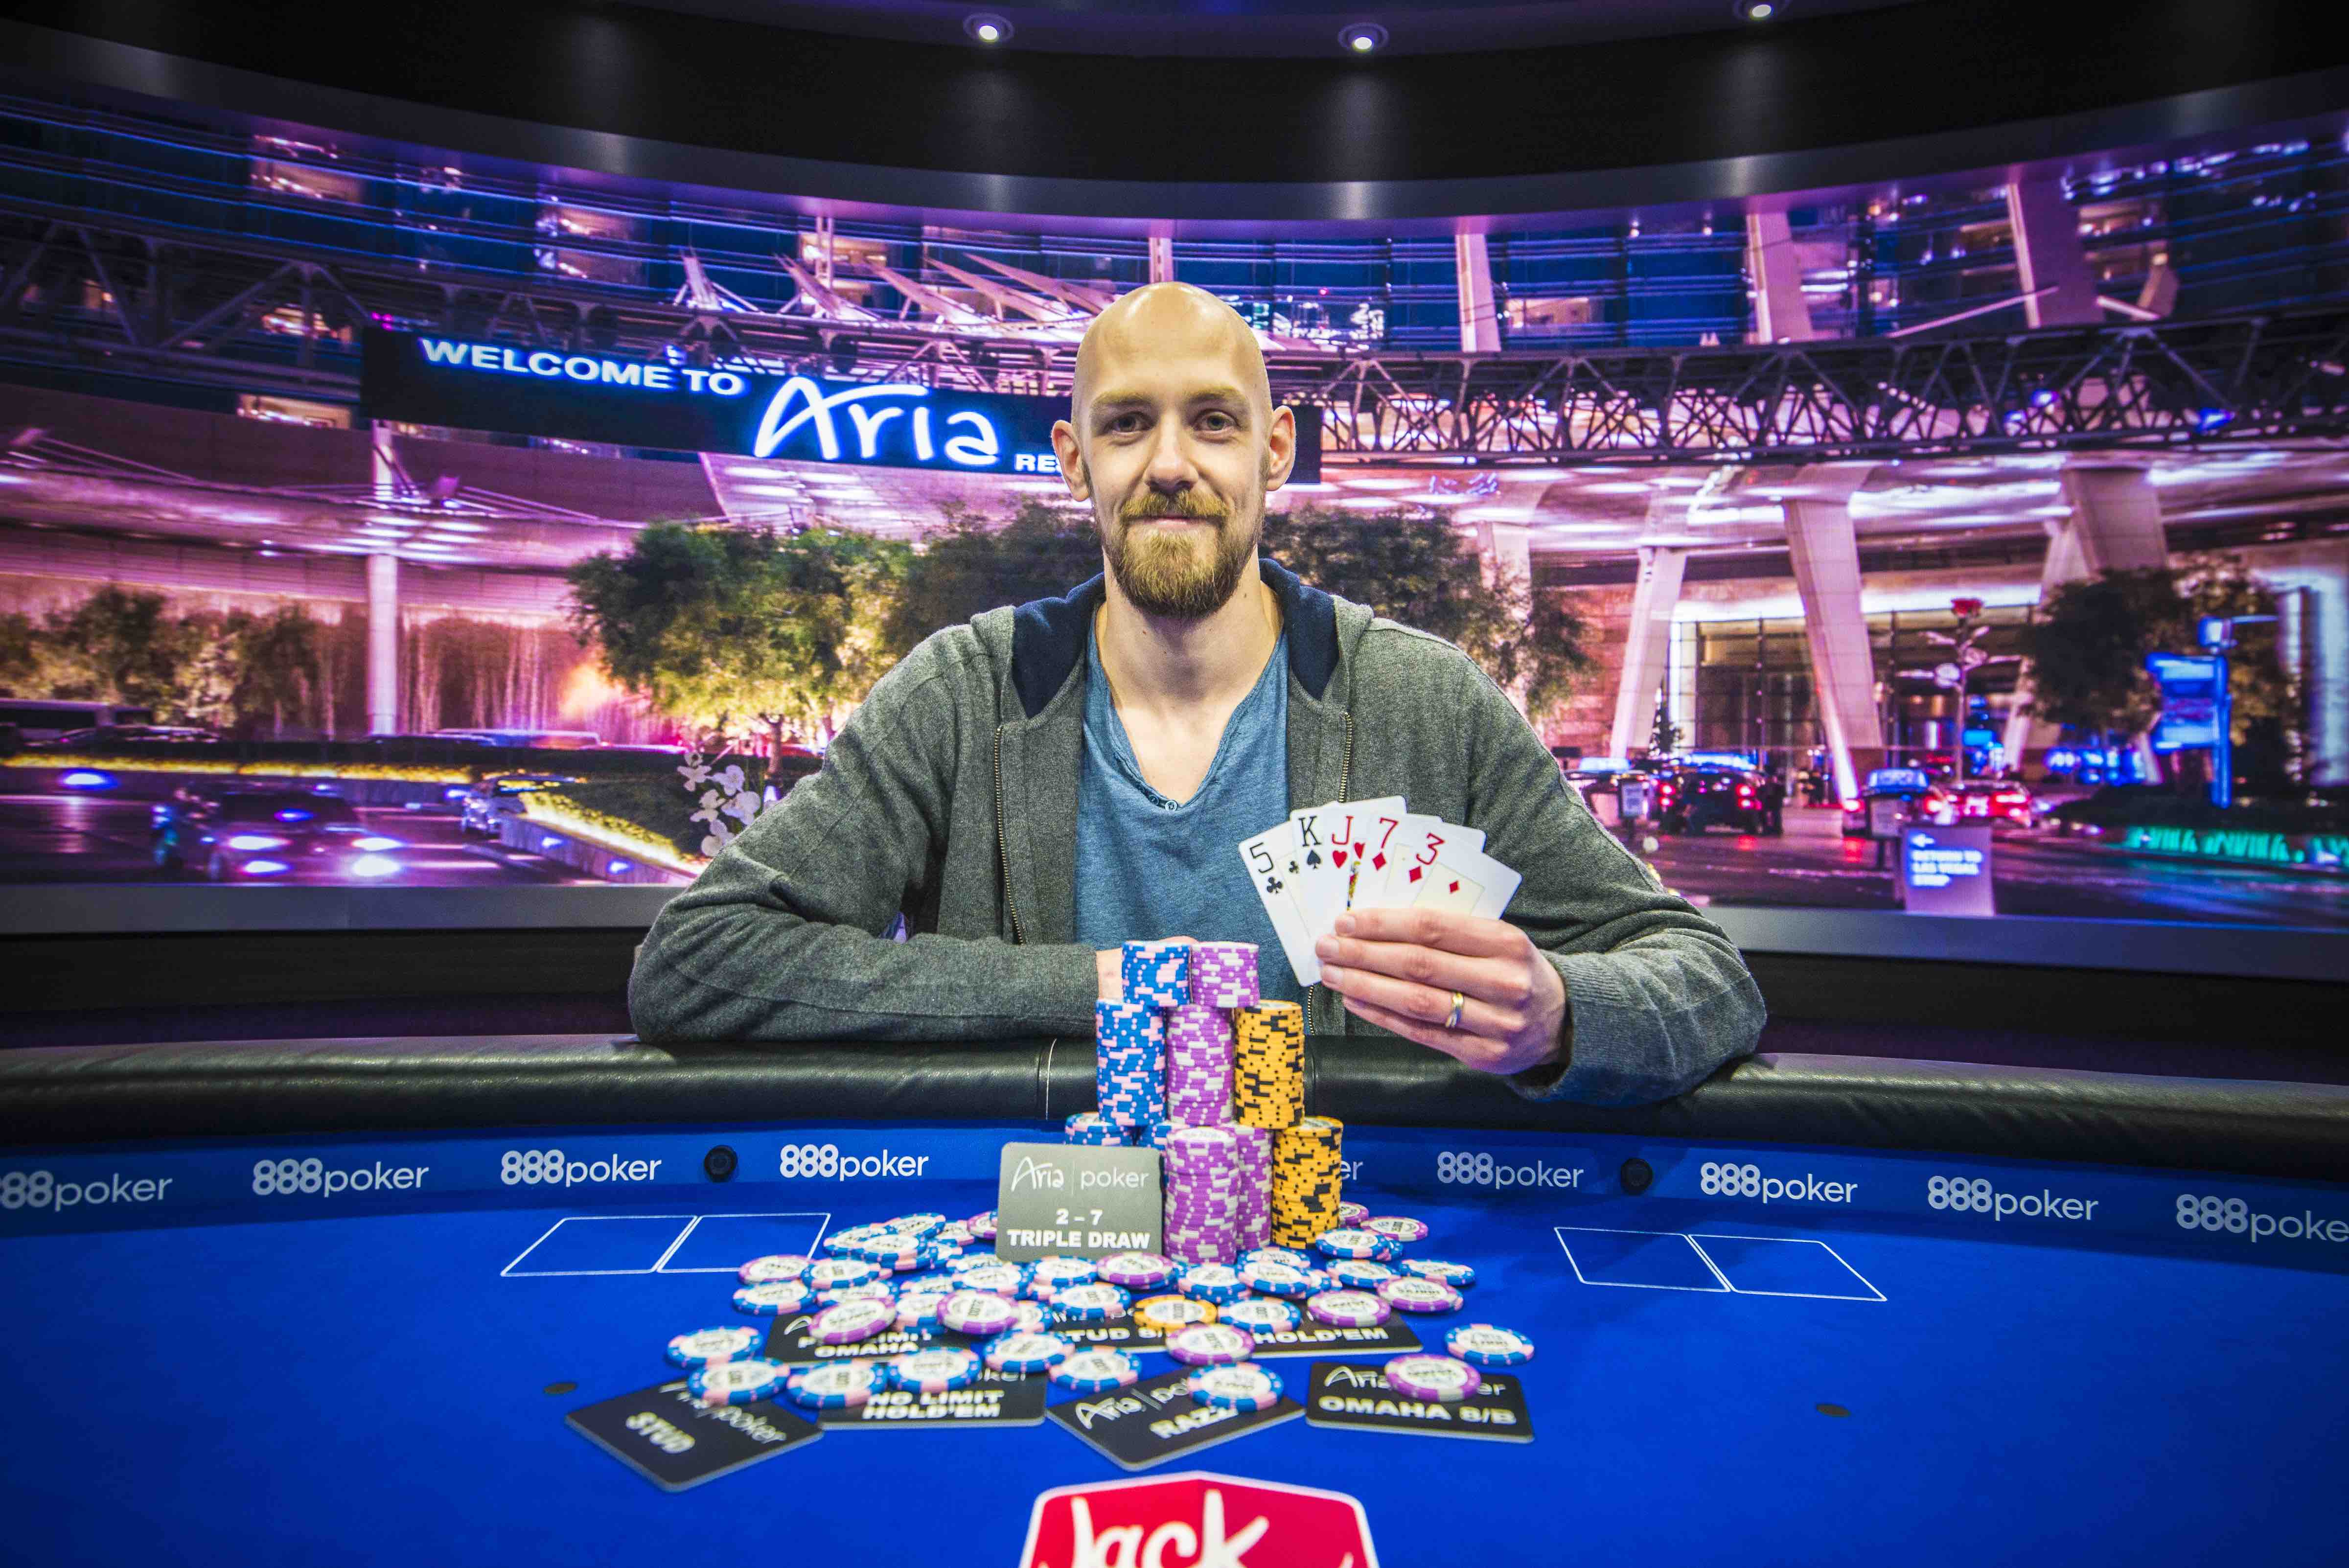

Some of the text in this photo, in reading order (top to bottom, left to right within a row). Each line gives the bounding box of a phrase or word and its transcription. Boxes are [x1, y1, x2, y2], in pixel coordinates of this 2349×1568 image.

[419, 337, 1062, 473] WELCOME TO Aria RE
[1297, 815, 1323, 847] K
[1331, 815, 1354, 846] J
[1379, 817, 1399, 849] 7
[1249, 842, 1274, 874] 5
[1416, 832, 1445, 866] 3
[252, 1157, 430, 1198] 888poker
[501, 1149, 662, 1188] 888poker
[780, 1144, 929, 1182] 888poker
[1011, 1156, 1150, 1192] Aria poker
[1436, 1151, 1584, 1190] 888poker
[0, 1170, 173, 1212] 88poker
[1700, 1162, 1858, 1203] 888poker
[1927, 1175, 2099, 1221] 888poker
[1006, 1229, 1151, 1249] TRIPLE DRAW
[814, 1340, 919, 1358] OMAHA
[1252, 1326, 1389, 1344] HOLD'EM
[862, 1403, 1001, 1420] HOLD'EM
[868, 1390, 1005, 1406] NO LIMIT
[1318, 1395, 1452, 1421] OMAHA
